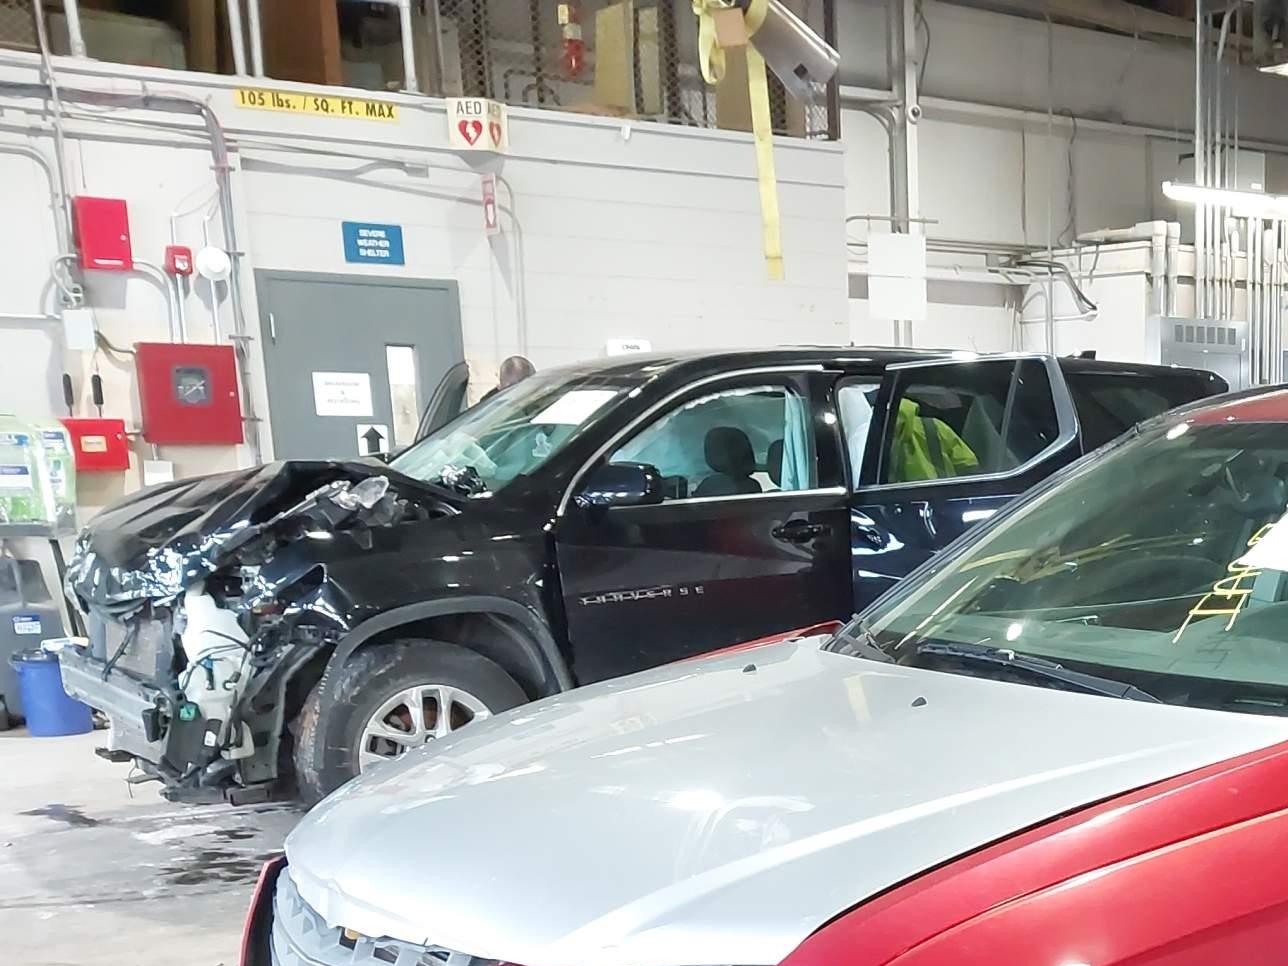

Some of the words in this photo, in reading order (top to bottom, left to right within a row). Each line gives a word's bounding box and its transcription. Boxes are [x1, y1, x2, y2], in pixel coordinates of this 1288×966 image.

[239, 90, 266, 107] 105
[271, 91, 297, 110] lbs.
[313, 97, 335, 114] SQ.
[341, 101, 359, 116] FT.
[365, 103, 395, 119] MAX
[456, 100, 483, 115] AED
[358, 247, 391, 258] SHELTER
